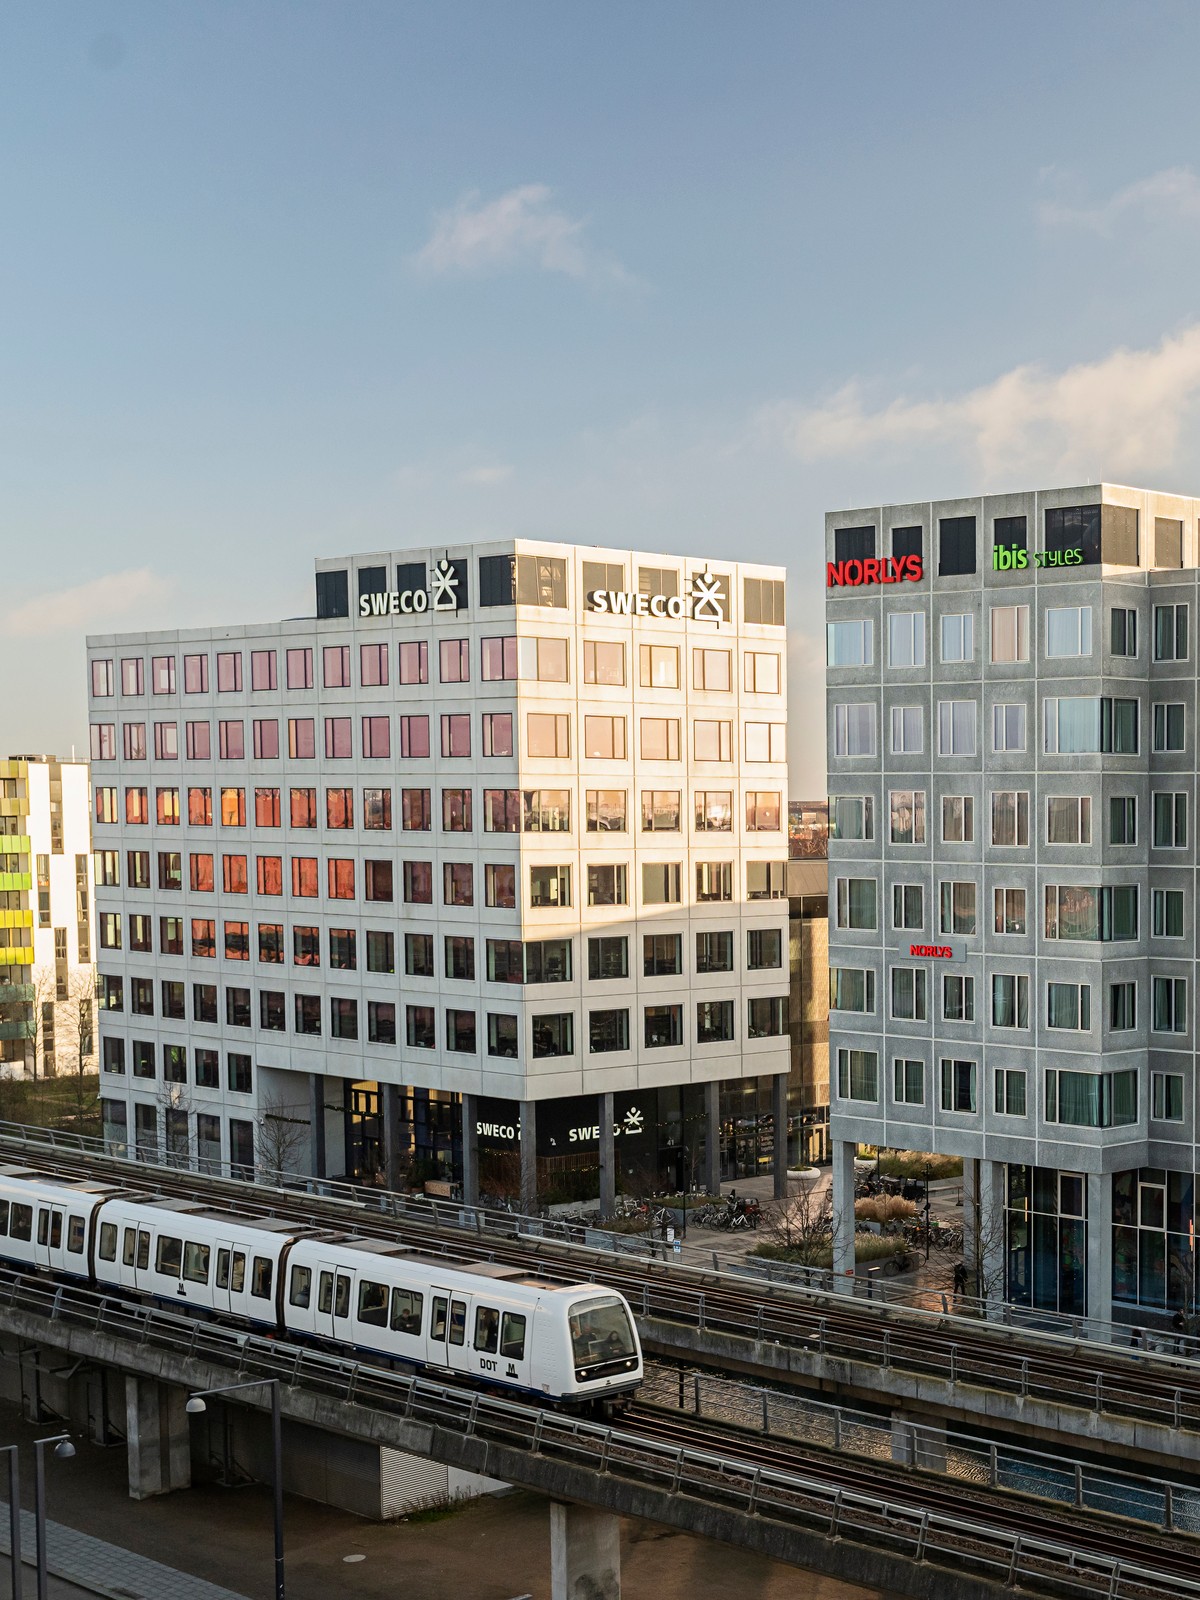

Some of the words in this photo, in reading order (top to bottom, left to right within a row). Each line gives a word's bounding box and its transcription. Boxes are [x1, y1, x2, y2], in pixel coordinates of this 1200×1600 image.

[993, 544, 1028, 571] ibis
[827, 554, 924, 588] NORLYS
[359, 589, 428, 617] SWECO
[592, 590, 686, 619] SWECO
[909, 944, 953, 959] NORLYS
[476, 1121, 515, 1140] SWECO
[569, 1123, 620, 1142] SWEO
[480, 1358, 498, 1371] DOT
